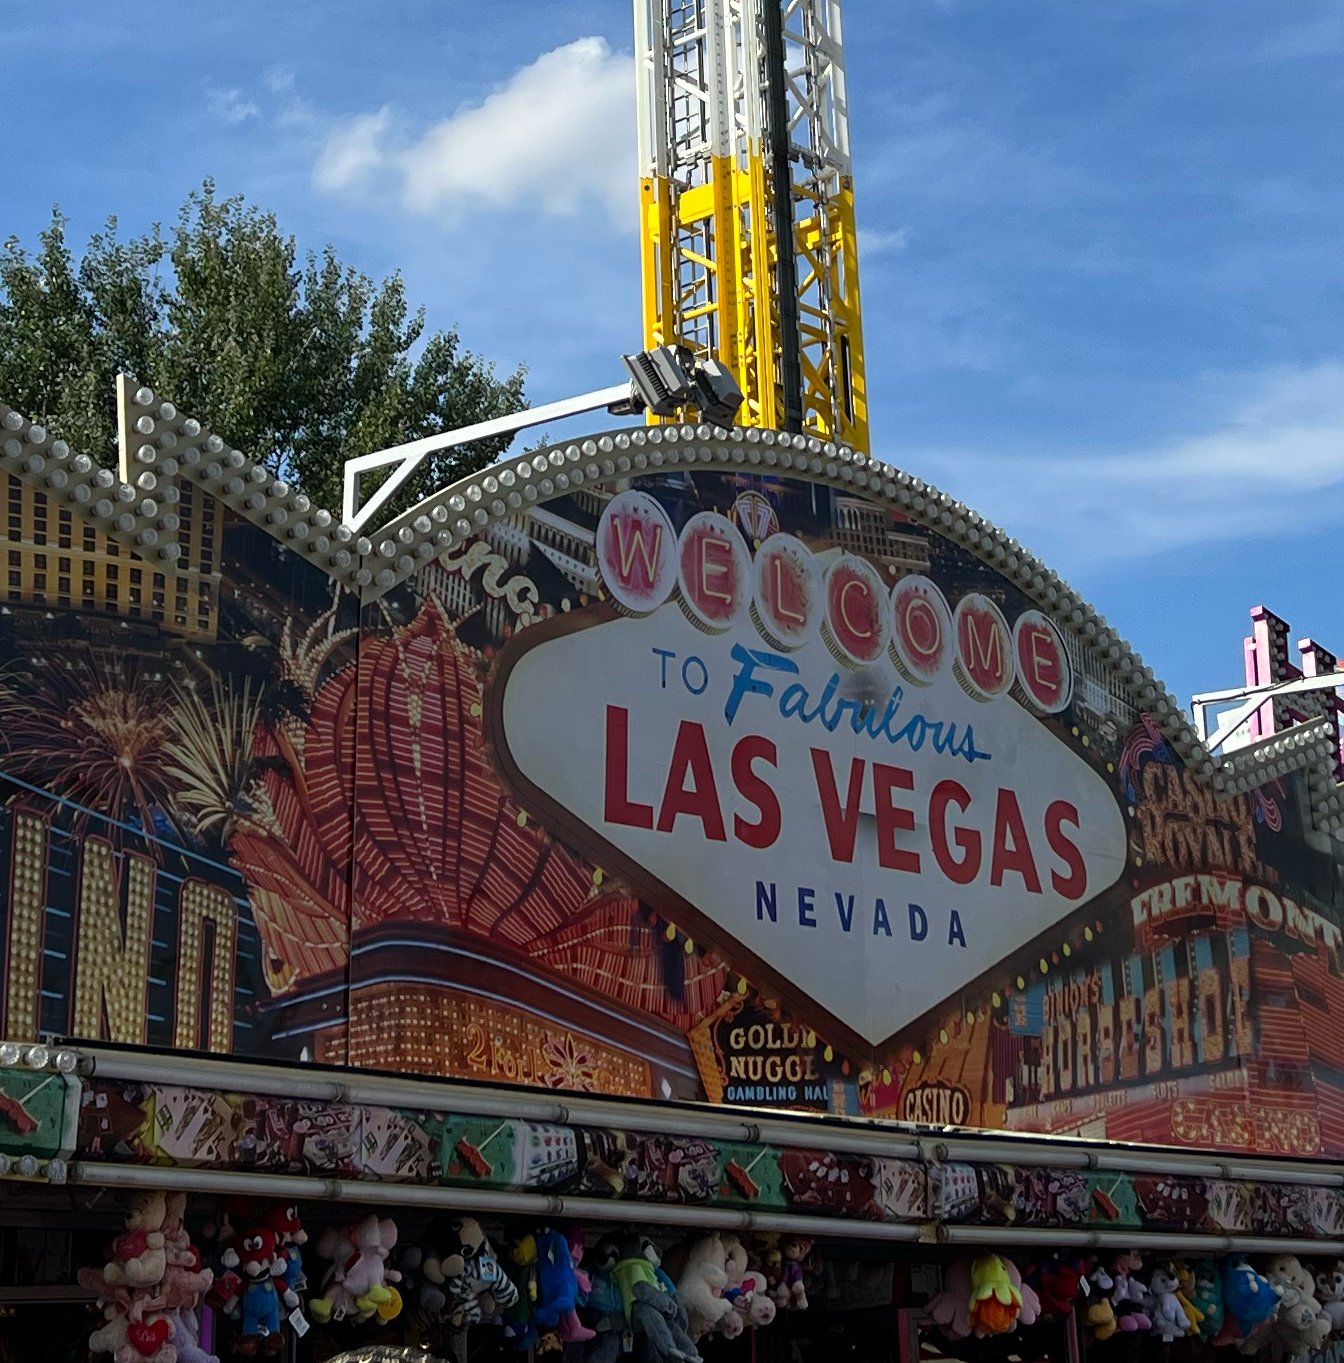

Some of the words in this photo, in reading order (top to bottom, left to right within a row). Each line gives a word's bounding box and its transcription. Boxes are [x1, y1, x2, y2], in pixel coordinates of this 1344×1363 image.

[609, 514, 1060, 693] WELCOME
[651, 647, 709, 696] TO
[723, 642, 992, 763] Fabulous
[603, 704, 782, 850] LAS
[809, 747, 1089, 902] VEGAS
[755, 880, 967, 949] NEVADA
[1130, 874, 1343, 952] FREMONT
[727, 1085, 797, 1101] GAMBLING
[905, 1087, 964, 1126] CASINO
